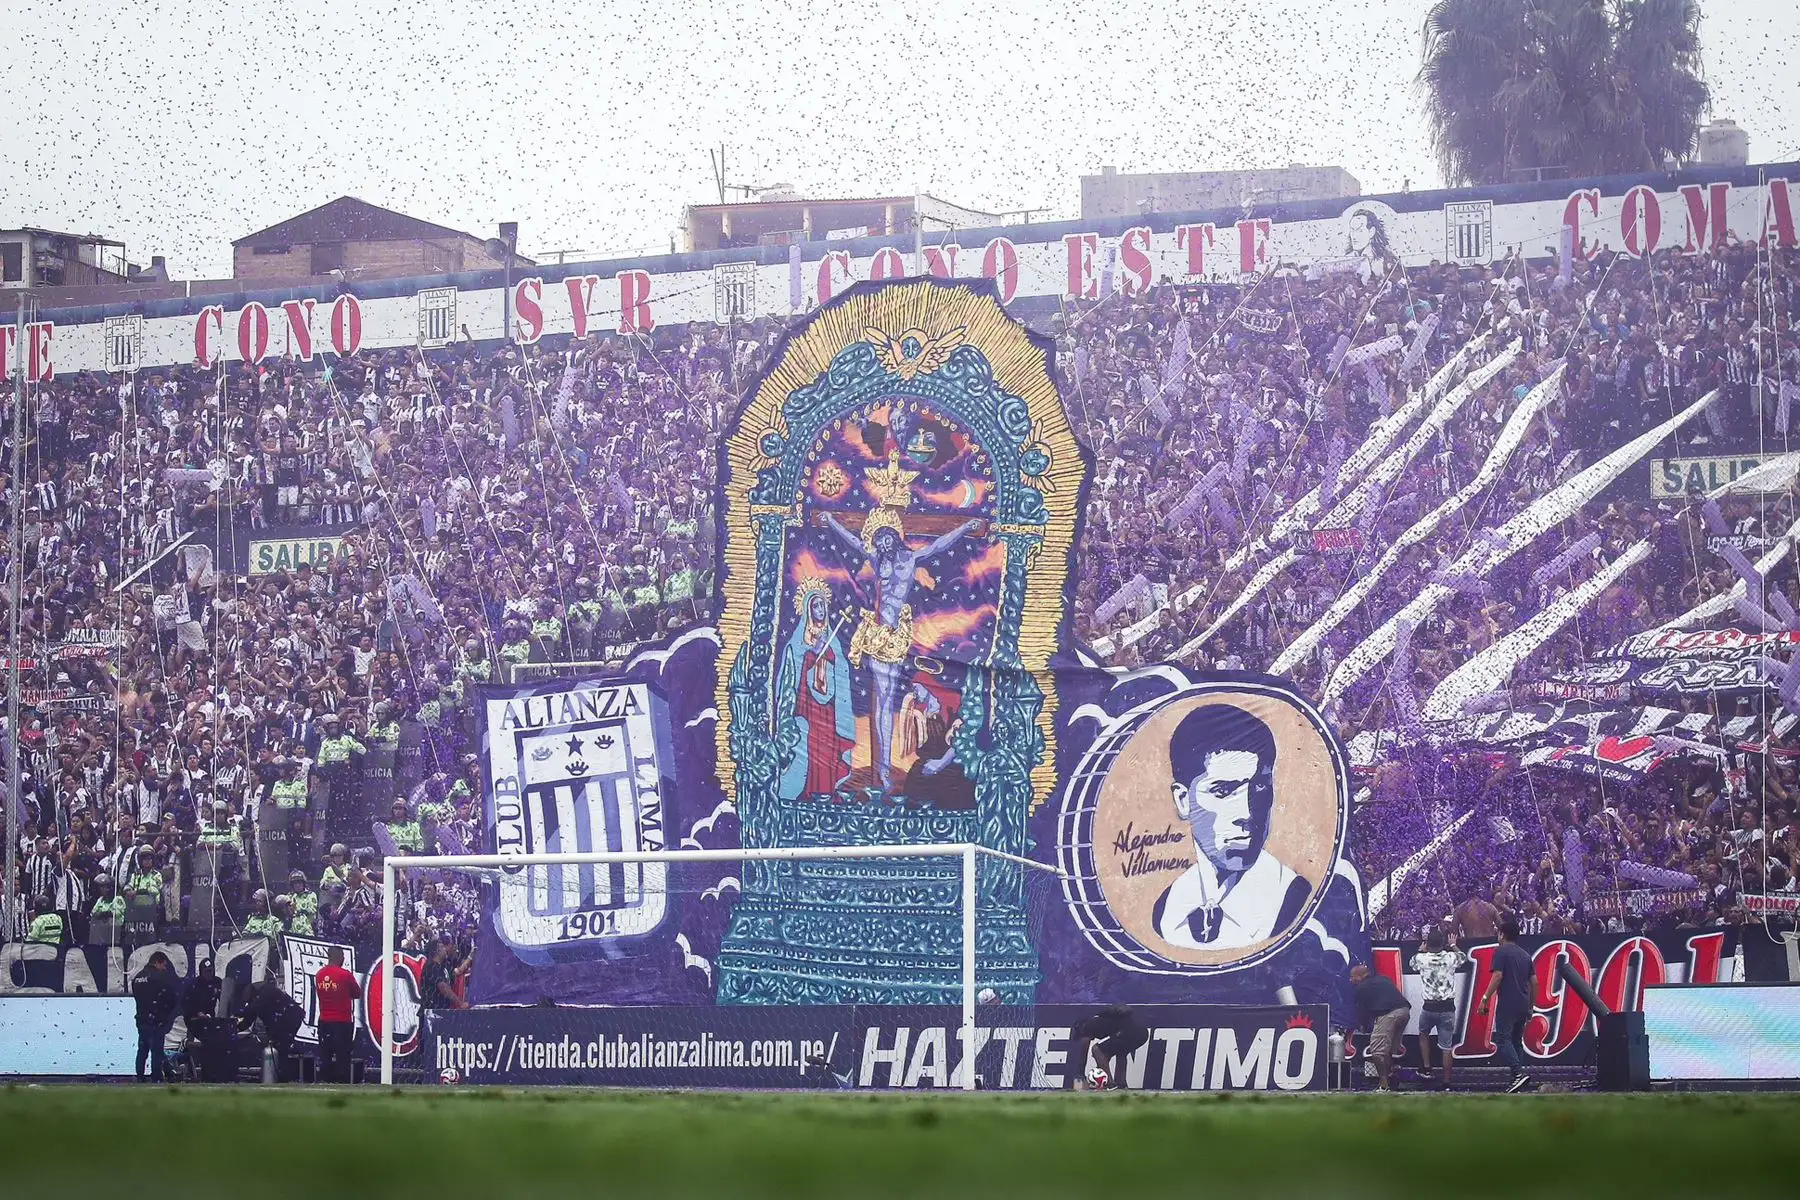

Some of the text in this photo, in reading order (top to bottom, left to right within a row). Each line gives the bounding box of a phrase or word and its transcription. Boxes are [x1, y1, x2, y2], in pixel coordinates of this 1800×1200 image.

[1563, 178, 1800, 261] COMA
[1062, 218, 1273, 301] ESTE
[194, 293, 362, 371] CONO
[1663, 459, 1761, 493] SALI
[499, 686, 646, 730] ALIANZA
[633, 753, 664, 852] LIMA
[295, 943, 330, 959] ALIAN
[557, 910, 620, 940] 1901
[436, 1031, 839, 1077] https://tienda.clubalianzalima.com.pe/
[859, 1026, 1318, 1091] HAZTE NTIMO
